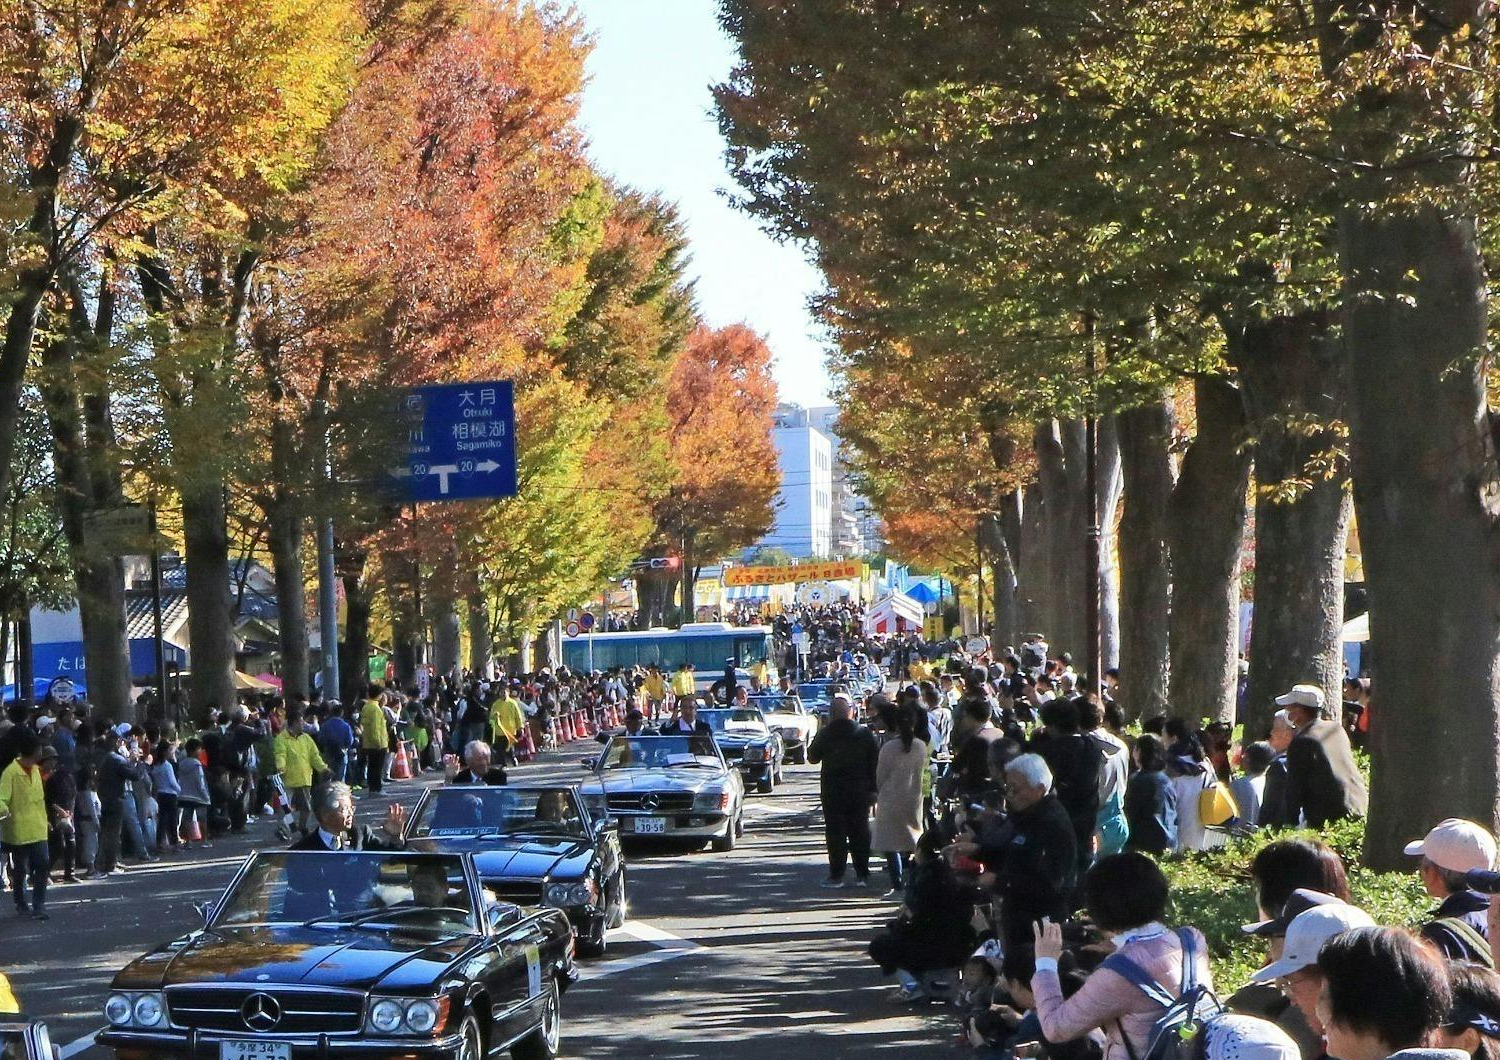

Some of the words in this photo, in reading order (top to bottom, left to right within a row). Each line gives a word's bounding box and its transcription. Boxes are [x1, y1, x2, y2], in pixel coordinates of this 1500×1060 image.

[458, 389, 496, 407] 大月
[463, 408, 492, 418] Otsuki
[452, 421, 506, 439] 相模湖
[456, 440, 502, 451] Sagamiko
[414, 464, 426, 475] 20
[461, 461, 473, 472] 20
